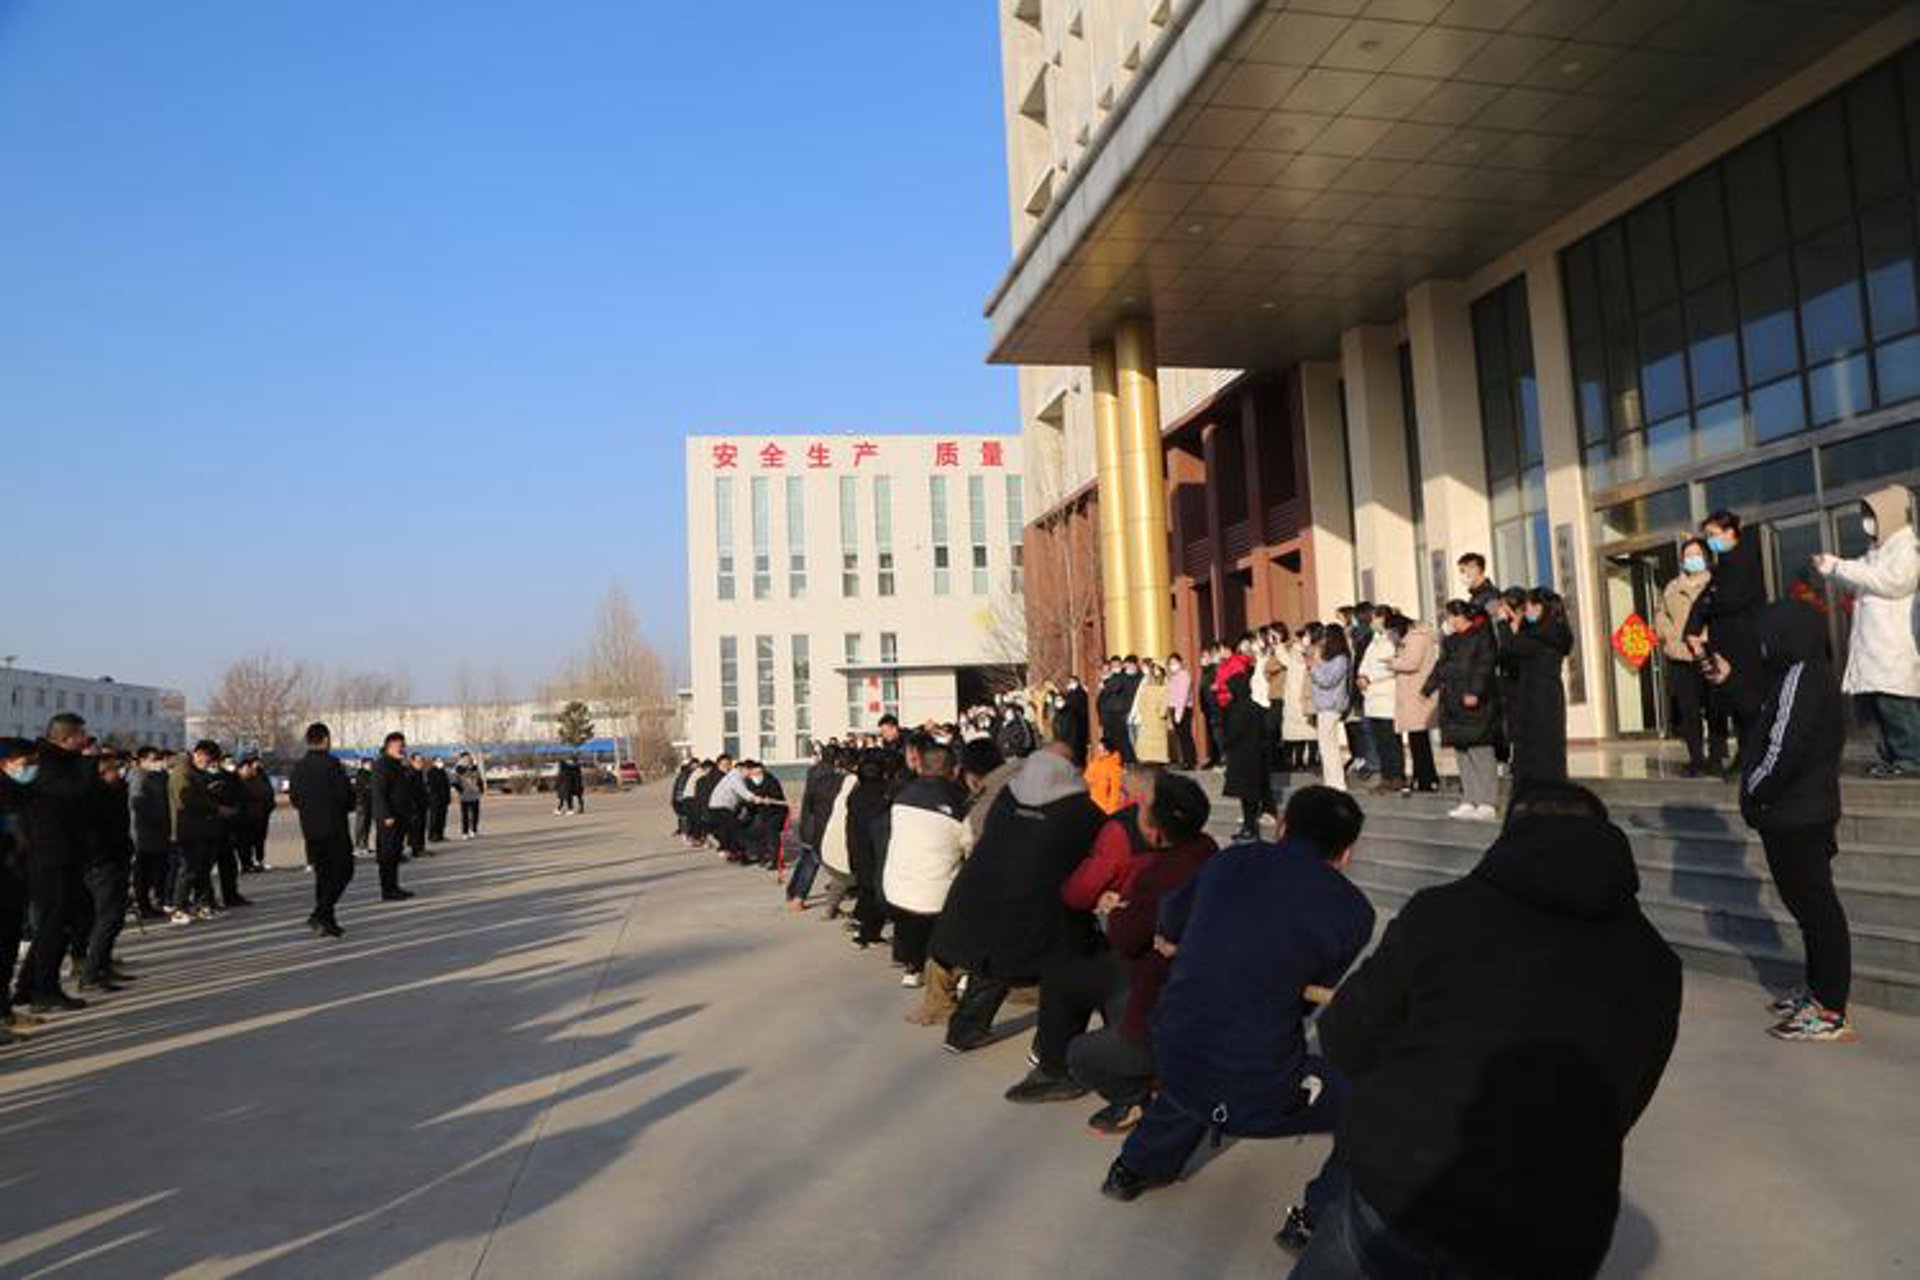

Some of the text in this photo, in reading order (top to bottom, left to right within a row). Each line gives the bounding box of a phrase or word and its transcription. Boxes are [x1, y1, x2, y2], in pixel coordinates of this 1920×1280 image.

[713, 441, 1003, 468] 安全生产 质量
